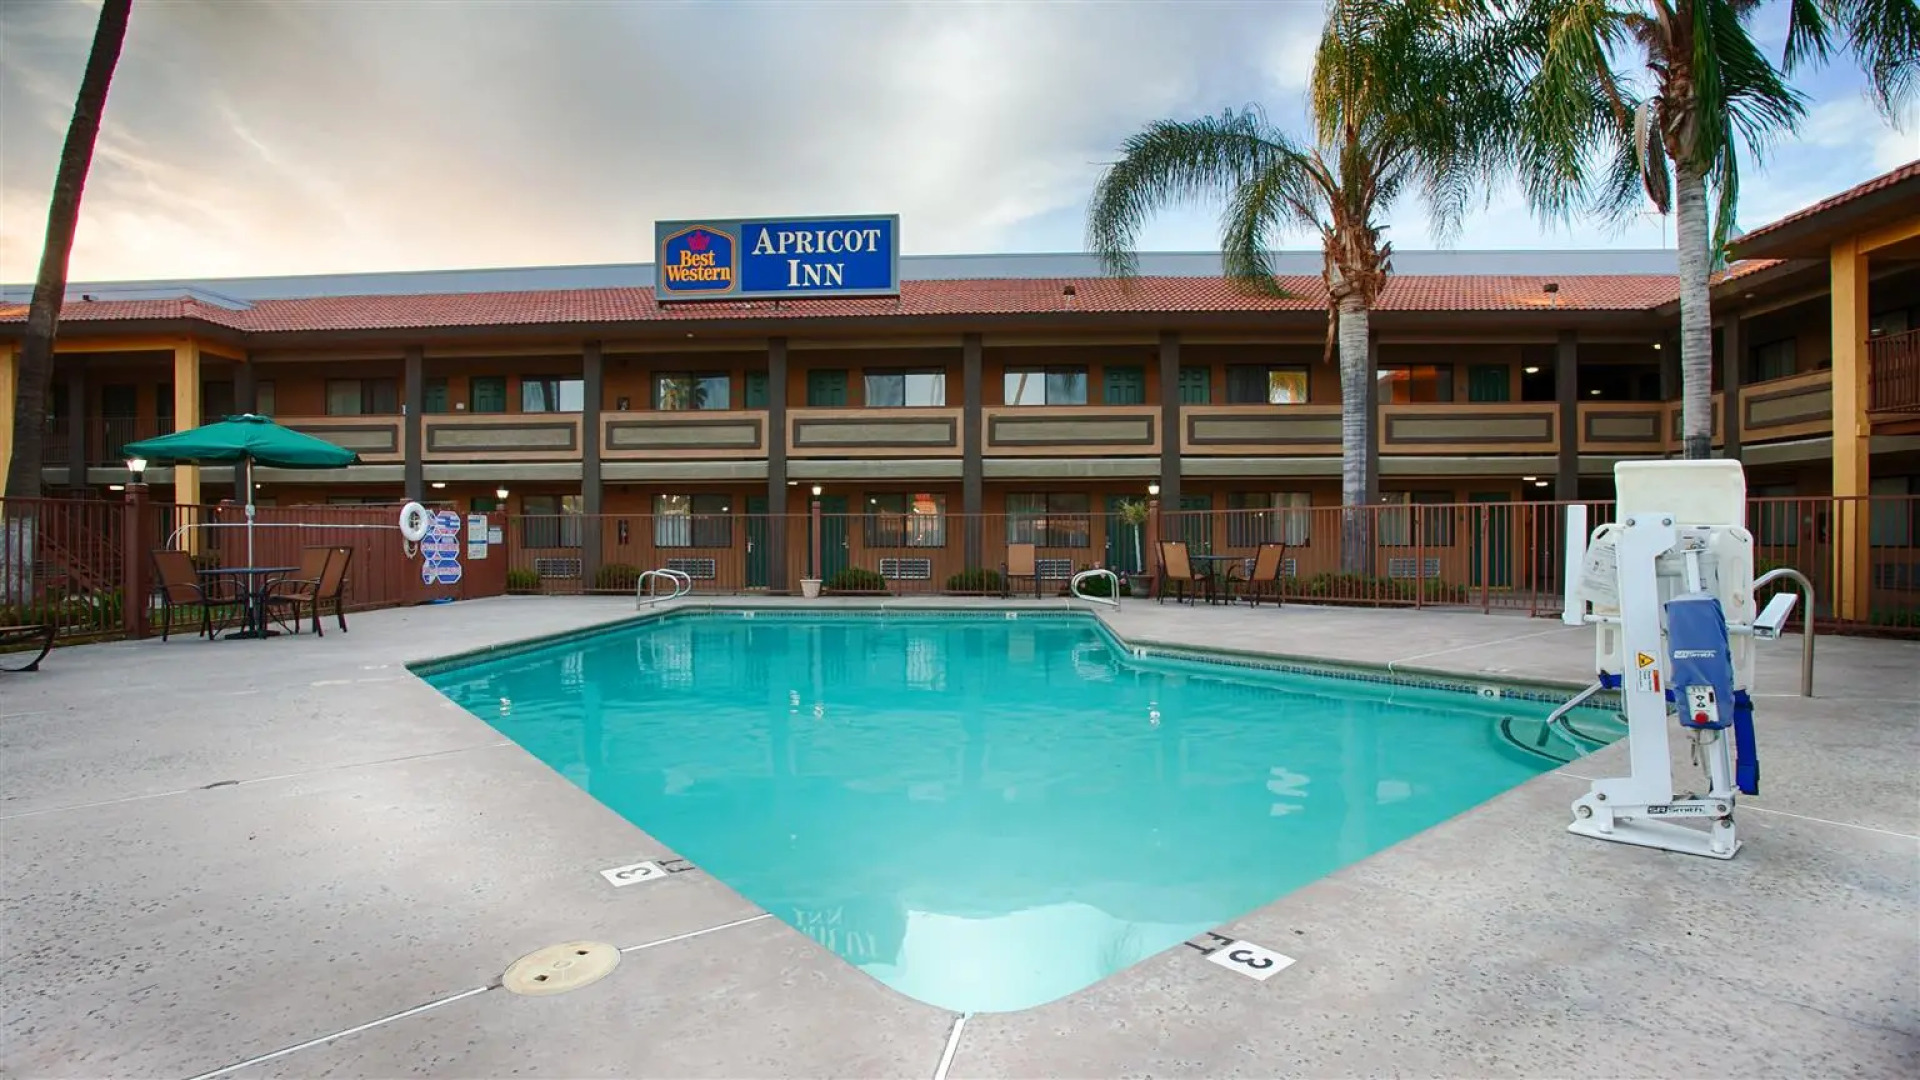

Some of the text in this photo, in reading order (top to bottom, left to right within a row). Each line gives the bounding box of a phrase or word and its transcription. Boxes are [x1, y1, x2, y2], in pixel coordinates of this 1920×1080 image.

[751, 227, 881, 255] APRICOT
[679, 250, 716, 267] Best
[665, 265, 731, 282] Western
[787, 259, 845, 287] INN
[615, 867, 652, 880] 3
[1184, 932, 1274, 970] 3 FT
